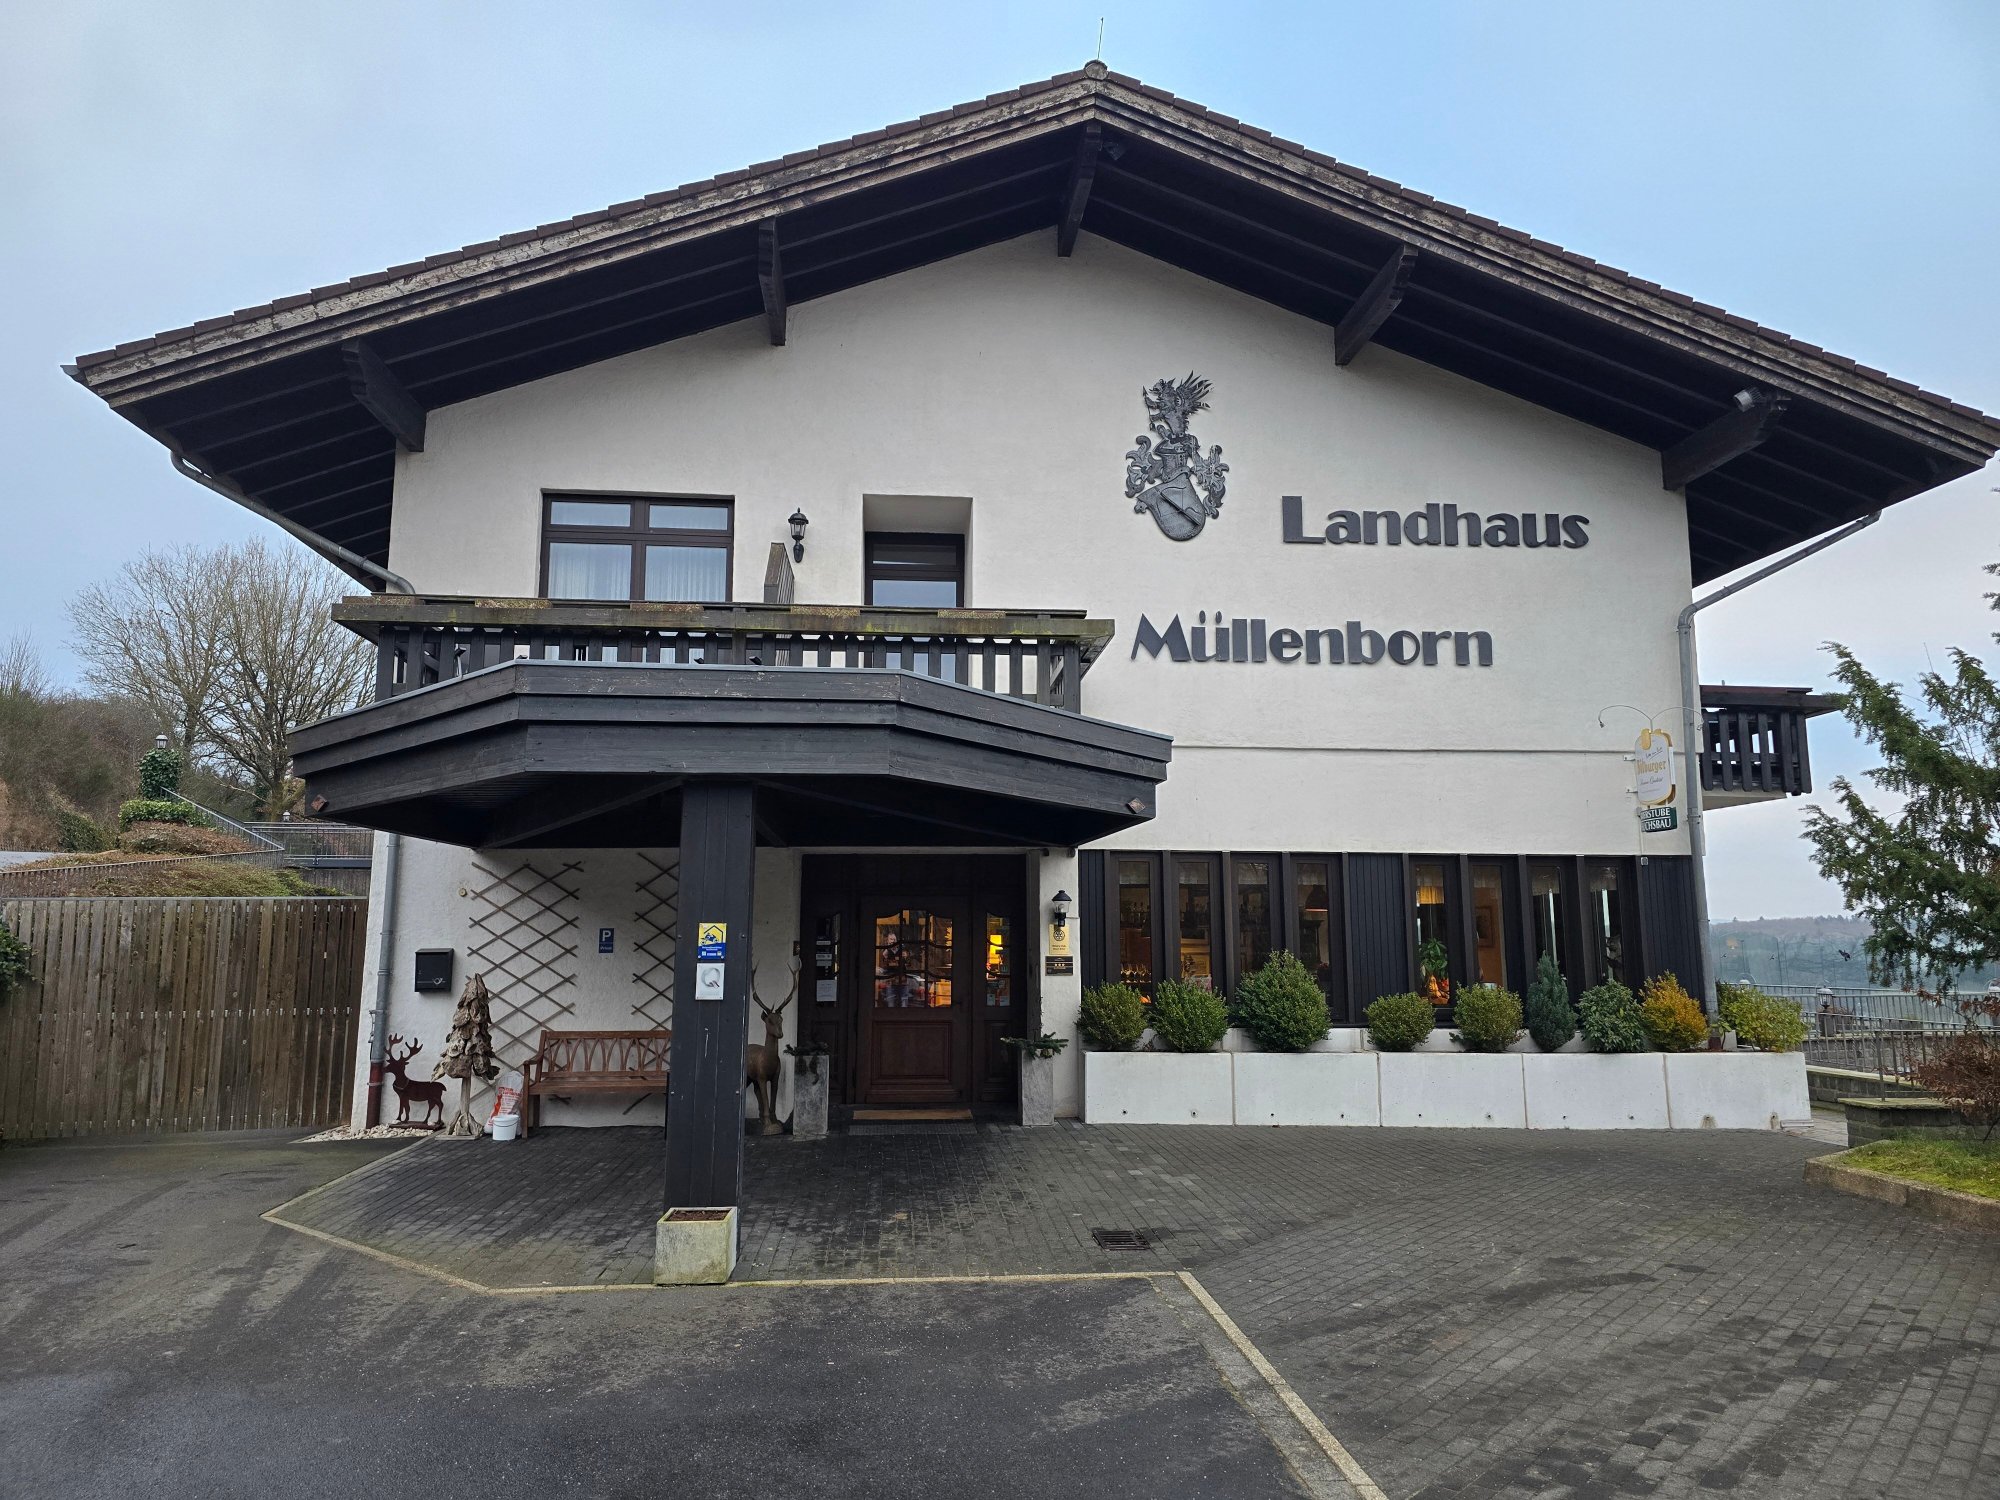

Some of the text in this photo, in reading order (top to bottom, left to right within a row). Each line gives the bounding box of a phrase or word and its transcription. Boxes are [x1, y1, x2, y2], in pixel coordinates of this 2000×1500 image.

[1282, 495, 1590, 549] Landhaus
[1131, 610, 1493, 666] Müllenborn
[602, 930, 612, 942] P
